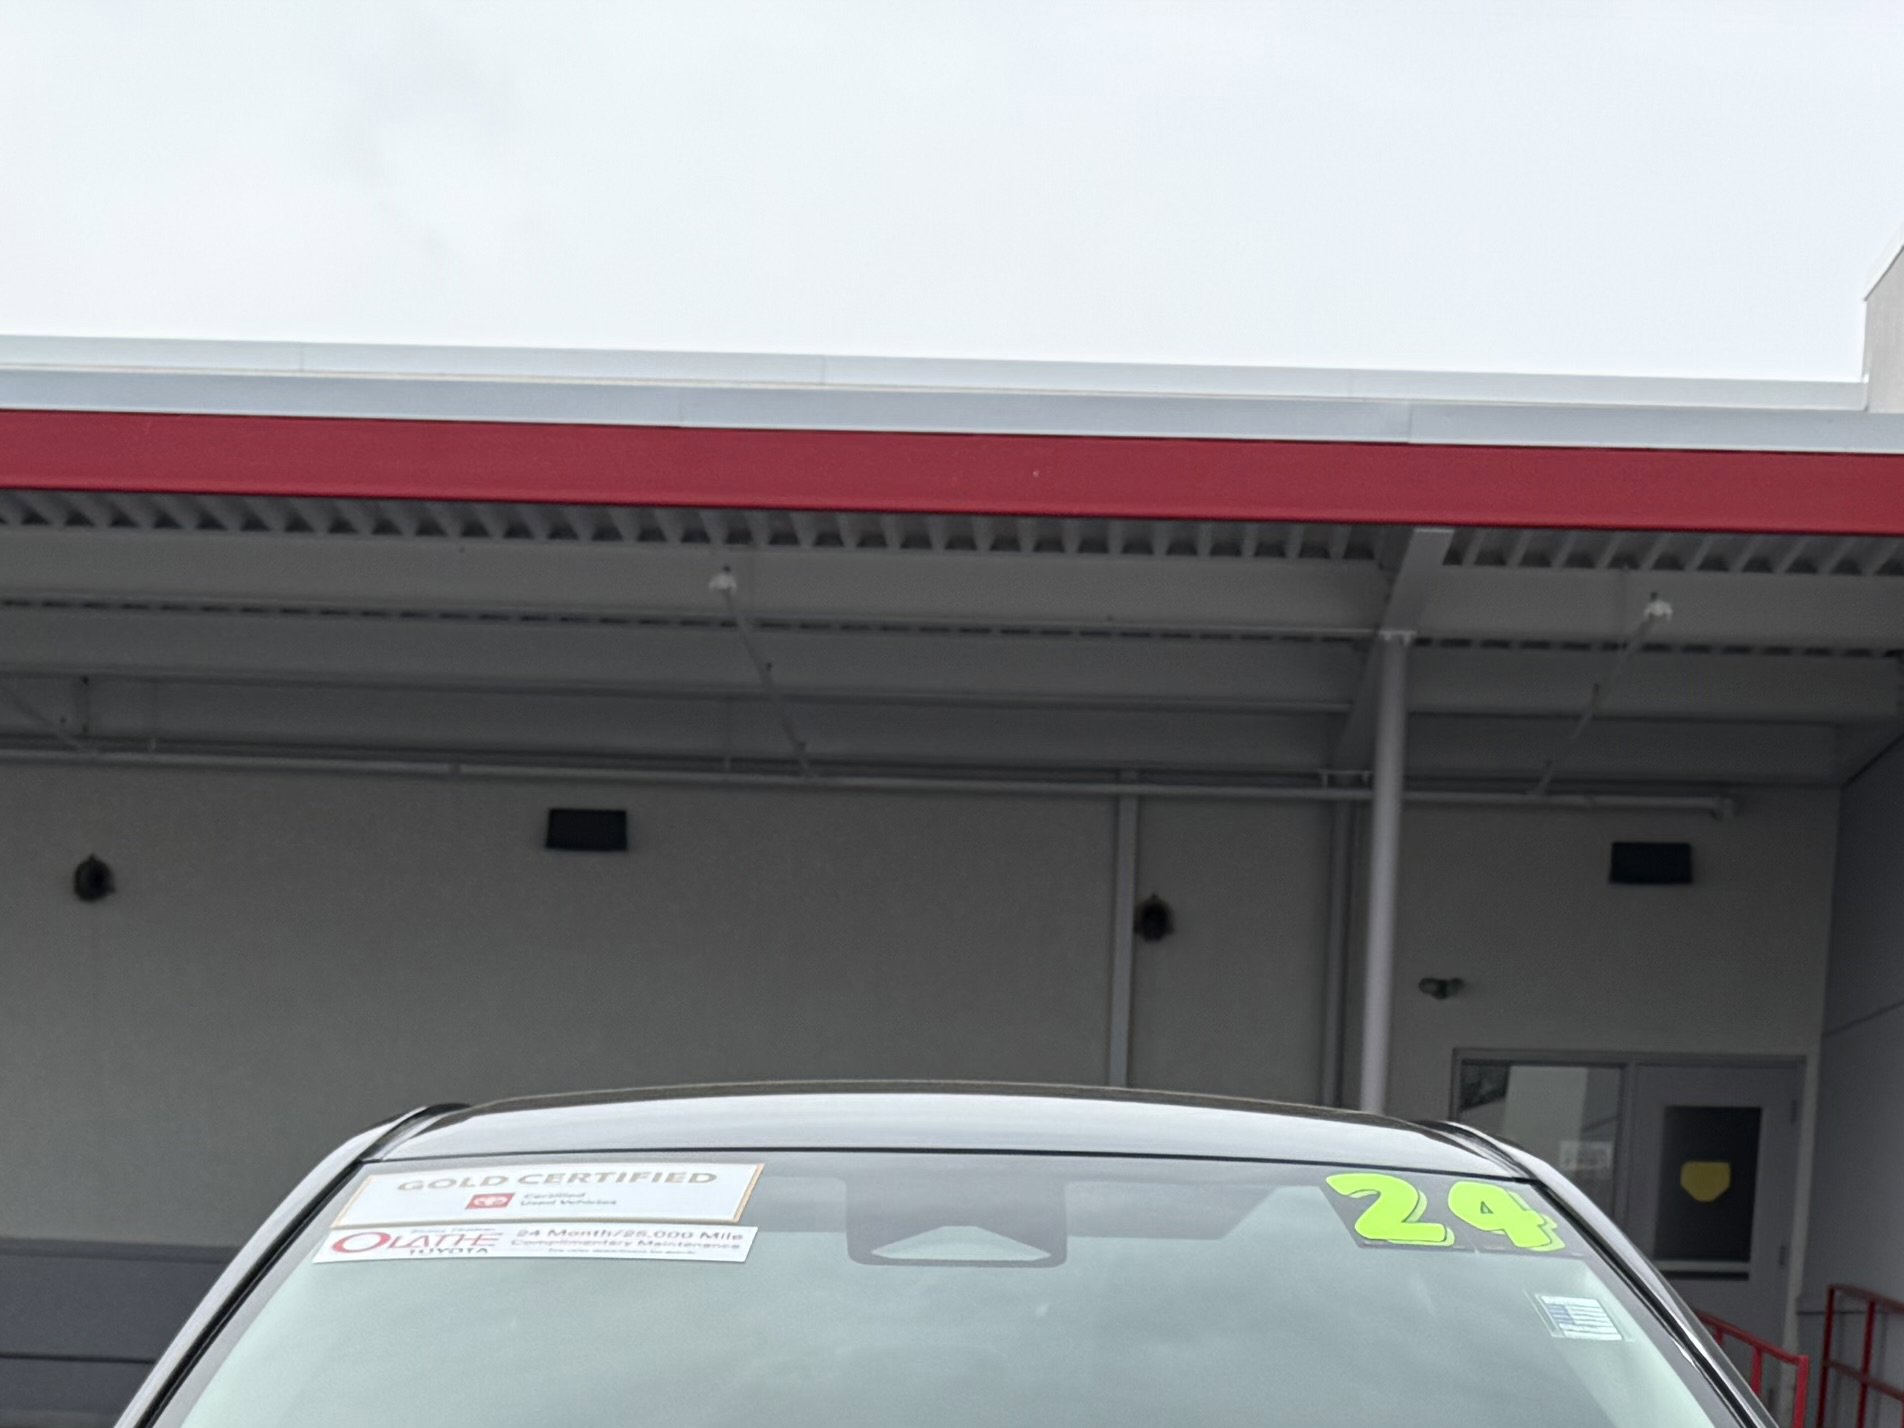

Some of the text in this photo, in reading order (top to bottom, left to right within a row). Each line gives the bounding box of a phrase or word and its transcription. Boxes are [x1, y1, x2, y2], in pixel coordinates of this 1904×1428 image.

[397, 1171, 718, 1191] GOLD CERTIFIED
[1325, 1172, 1566, 1252] 24
[331, 1231, 504, 1254] OLATHE
[699, 1231, 744, 1241] Mile
[409, 1247, 489, 1255] TOYOTA
